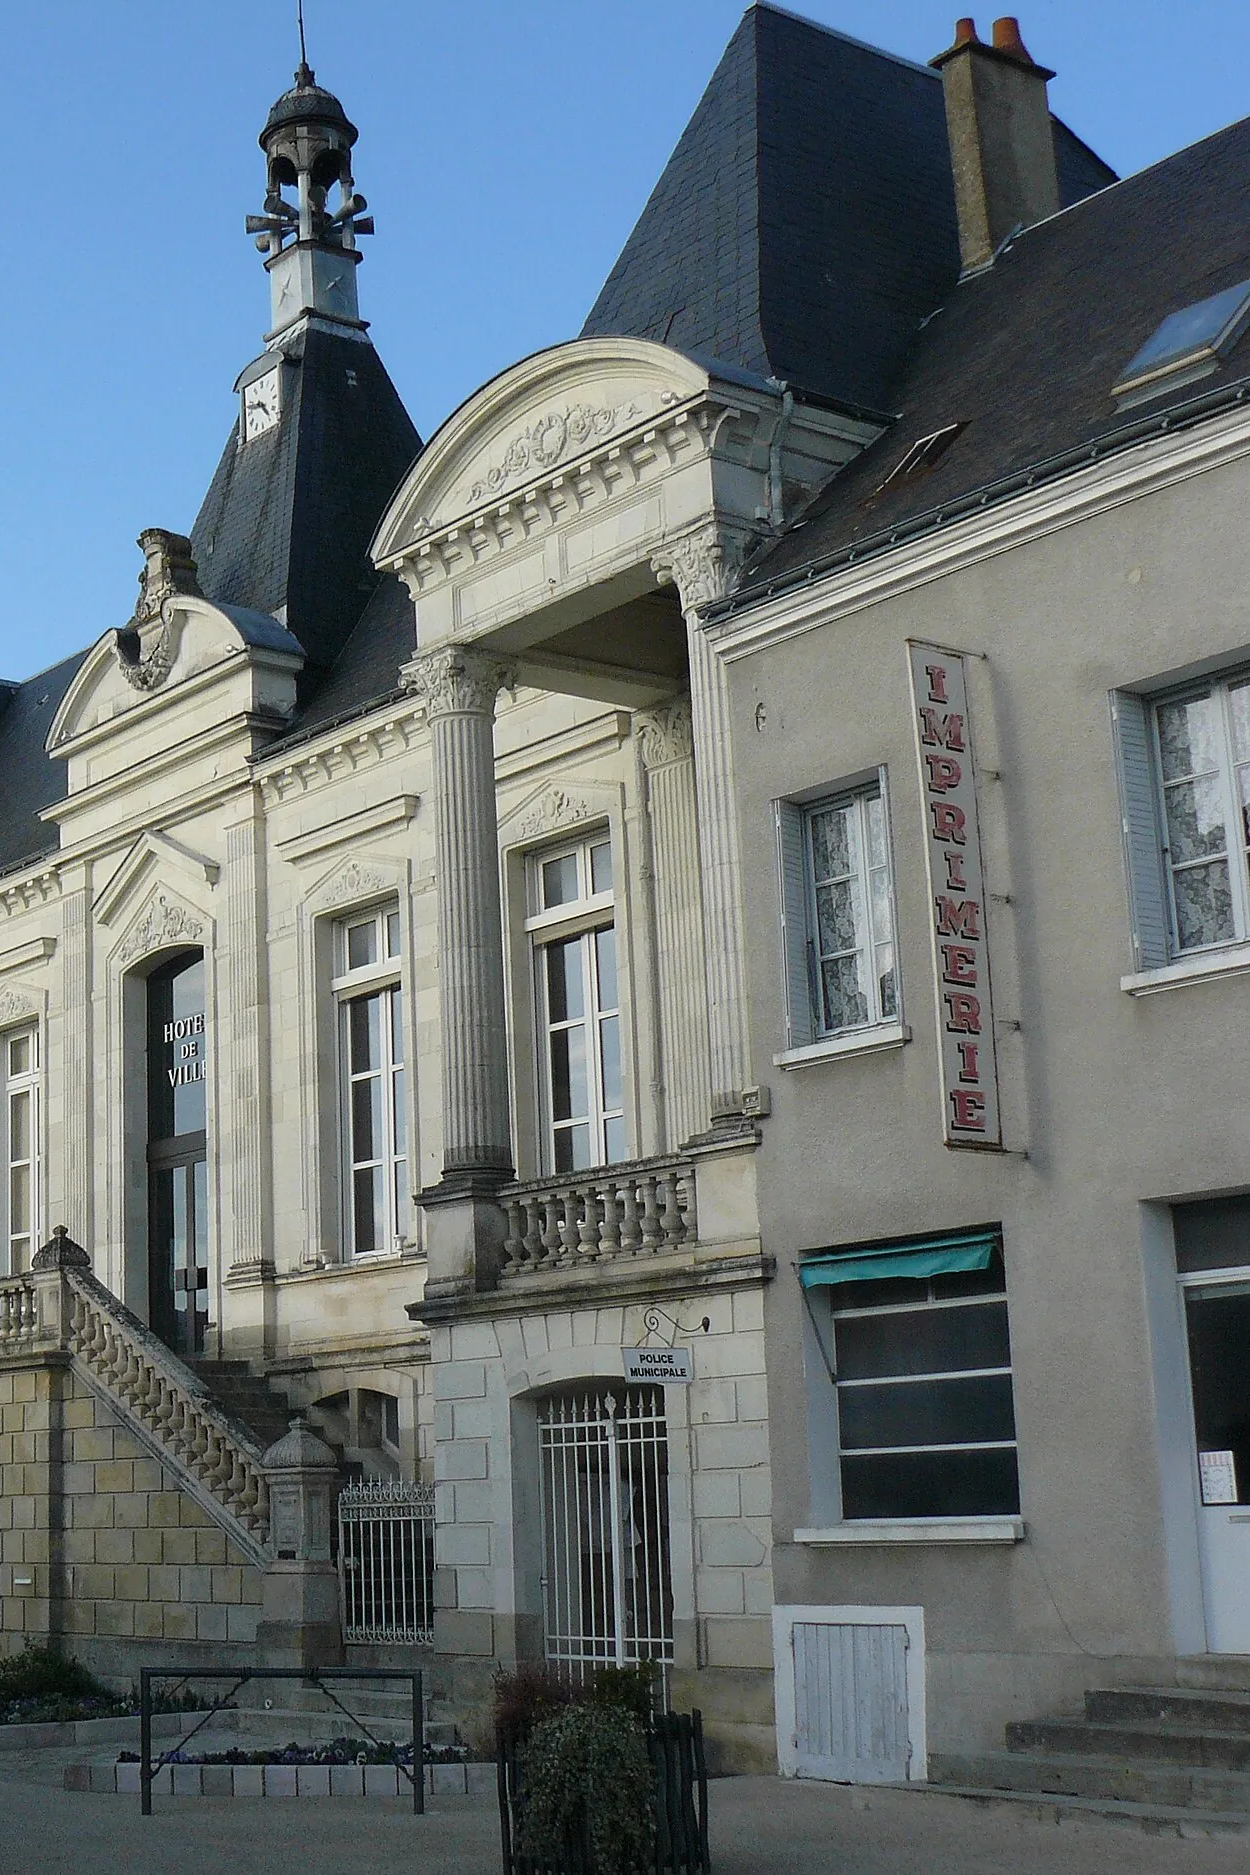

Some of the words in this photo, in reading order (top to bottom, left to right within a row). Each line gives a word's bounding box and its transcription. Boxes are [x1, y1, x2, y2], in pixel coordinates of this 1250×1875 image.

[920, 664, 986, 1132] IMPRIMERIE
[181, 1041, 197, 1059] DE
[639, 1354, 674, 1364] POLICE
[629, 1367, 687, 1377] MUNICIPALE
